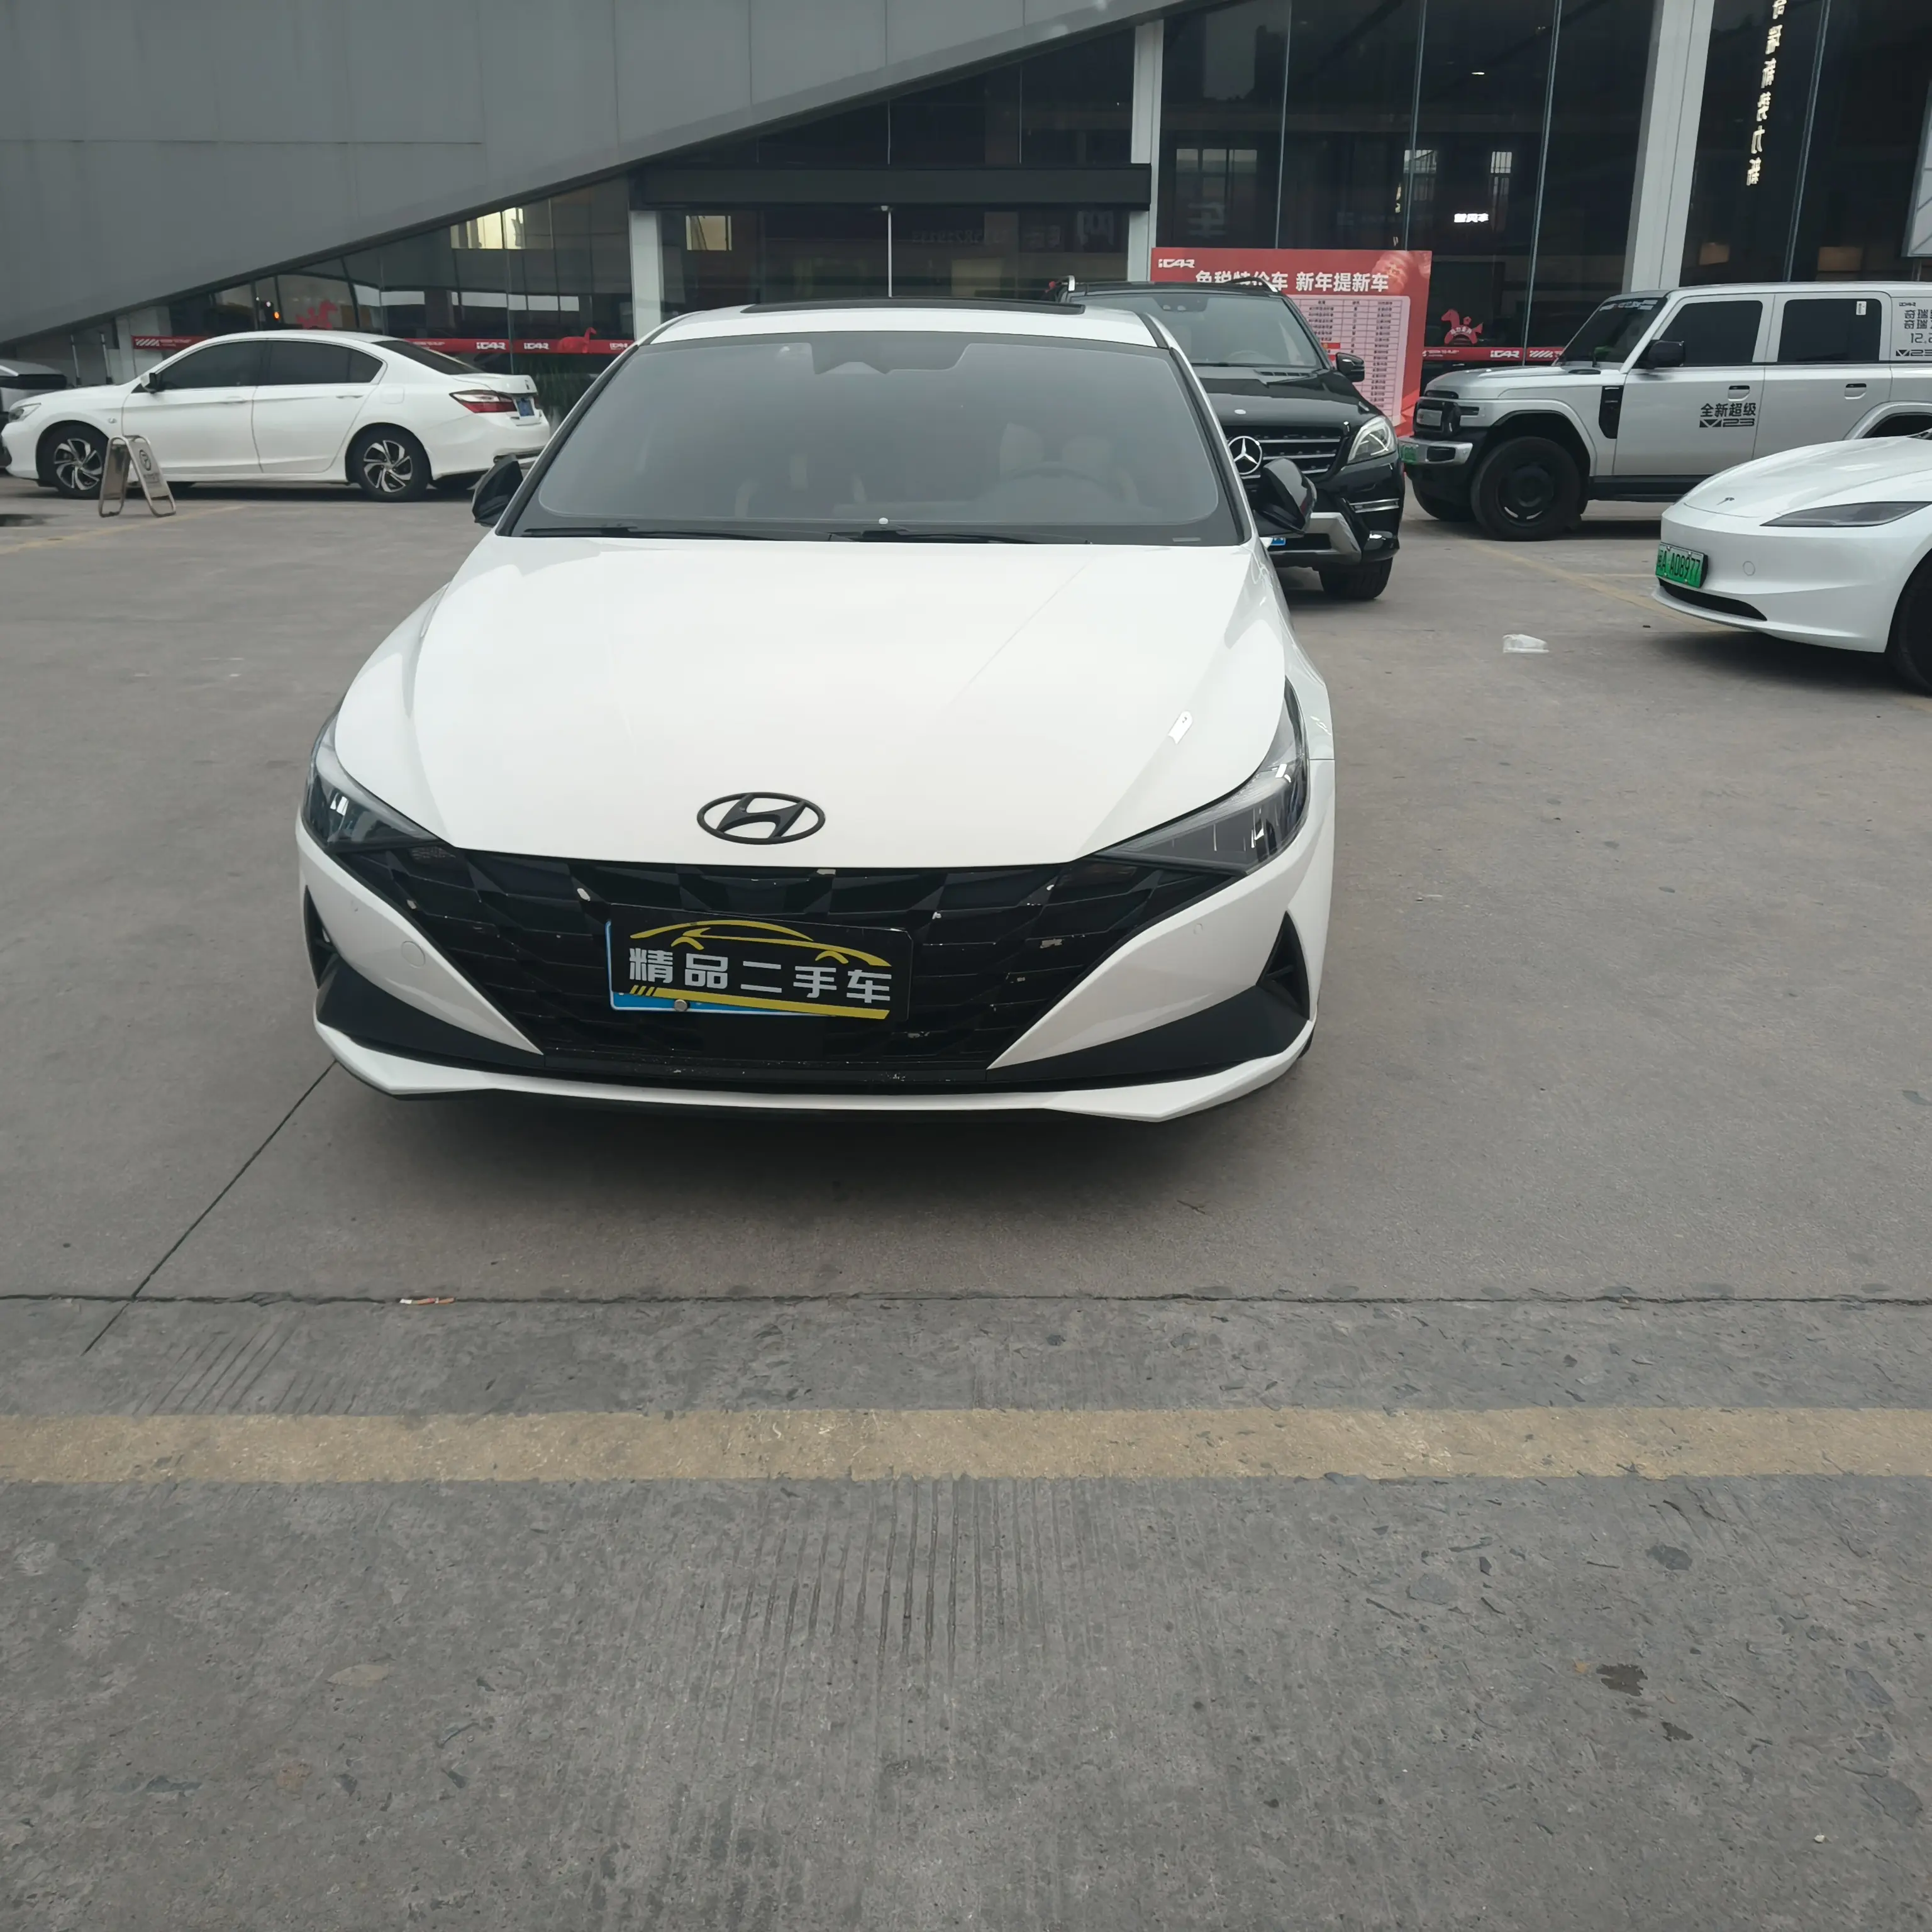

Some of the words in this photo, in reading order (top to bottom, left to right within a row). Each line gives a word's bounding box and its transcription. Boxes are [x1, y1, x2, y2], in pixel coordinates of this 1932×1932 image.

[1296, 271, 1389, 292] 新年提新车
[1904, 309, 1932, 319] 奇瑞
[1903, 319, 1932, 329] 奇瑞
[1700, 402, 1756, 418] 全新超级
[629, 947, 892, 1004] 精品二手车
